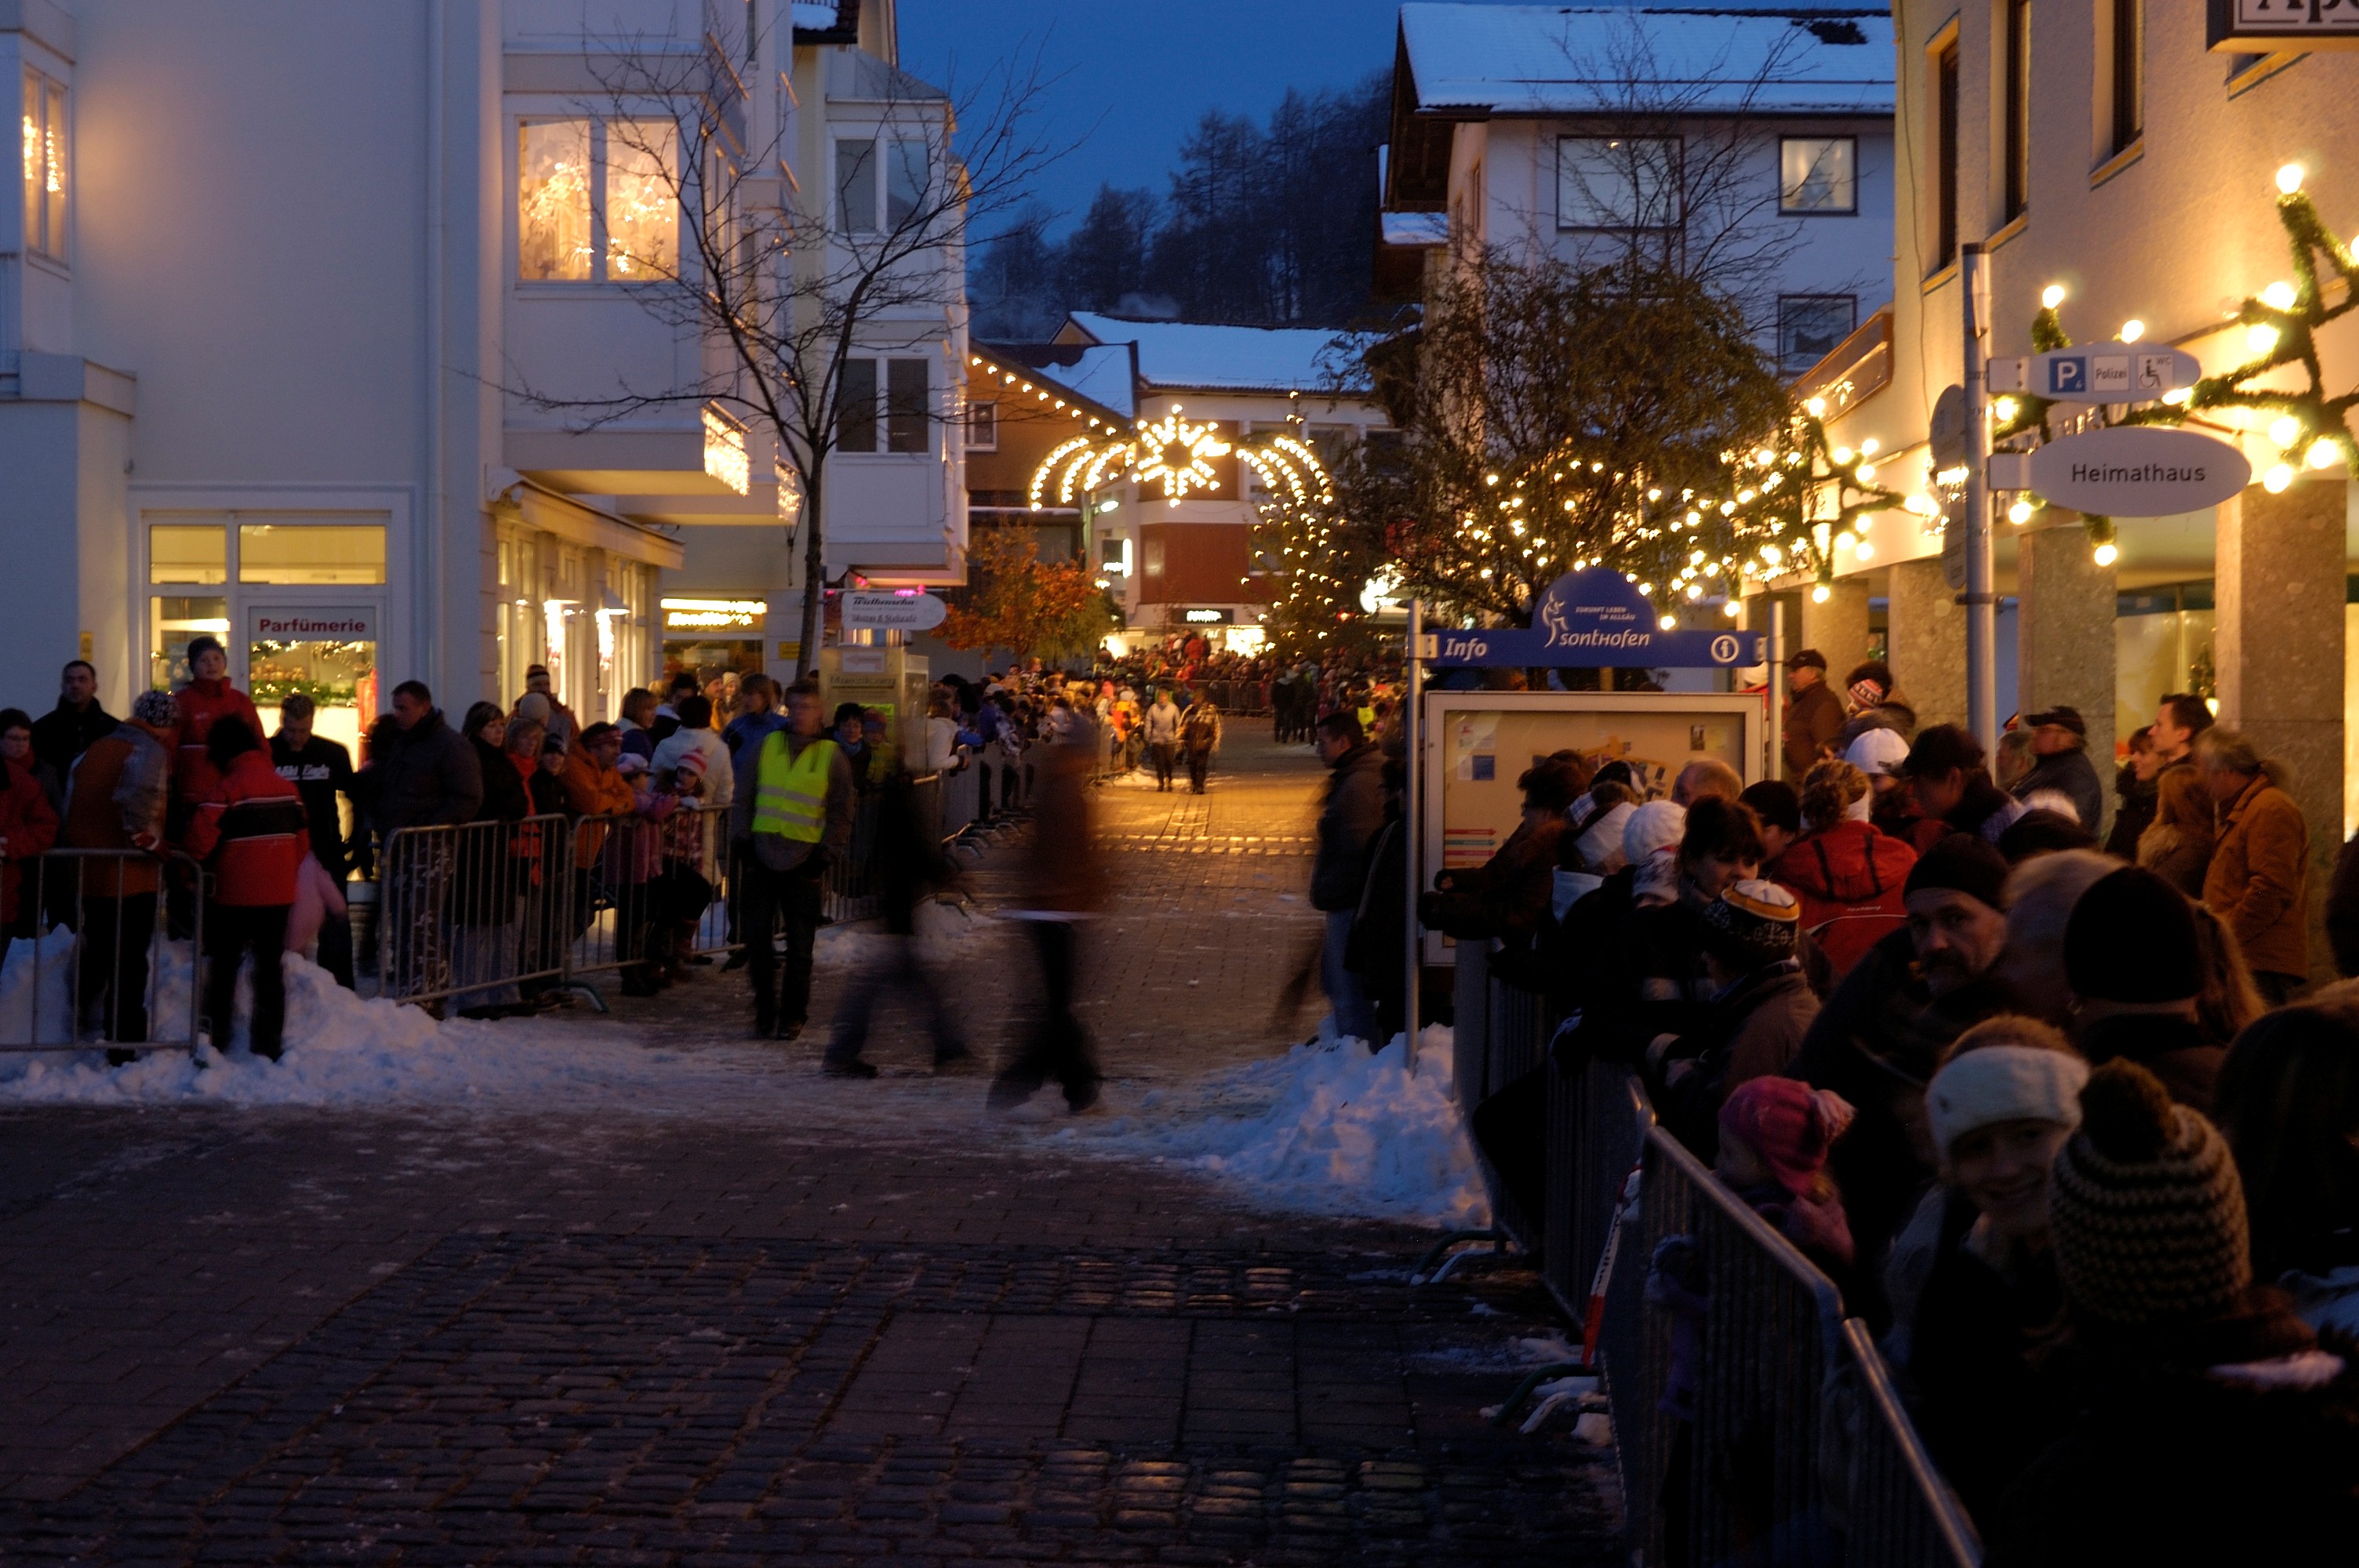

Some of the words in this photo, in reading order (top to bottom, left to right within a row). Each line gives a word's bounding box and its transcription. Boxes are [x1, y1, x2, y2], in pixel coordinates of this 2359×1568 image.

[2156, 356, 2172, 365] WC
[2057, 361, 2077, 389] P
[2095, 368, 2128, 380] Polizei
[2072, 463, 2206, 482] Heimathaus
[260, 618, 366, 633] Parfümerie
[1445, 638, 1488, 661] Info
